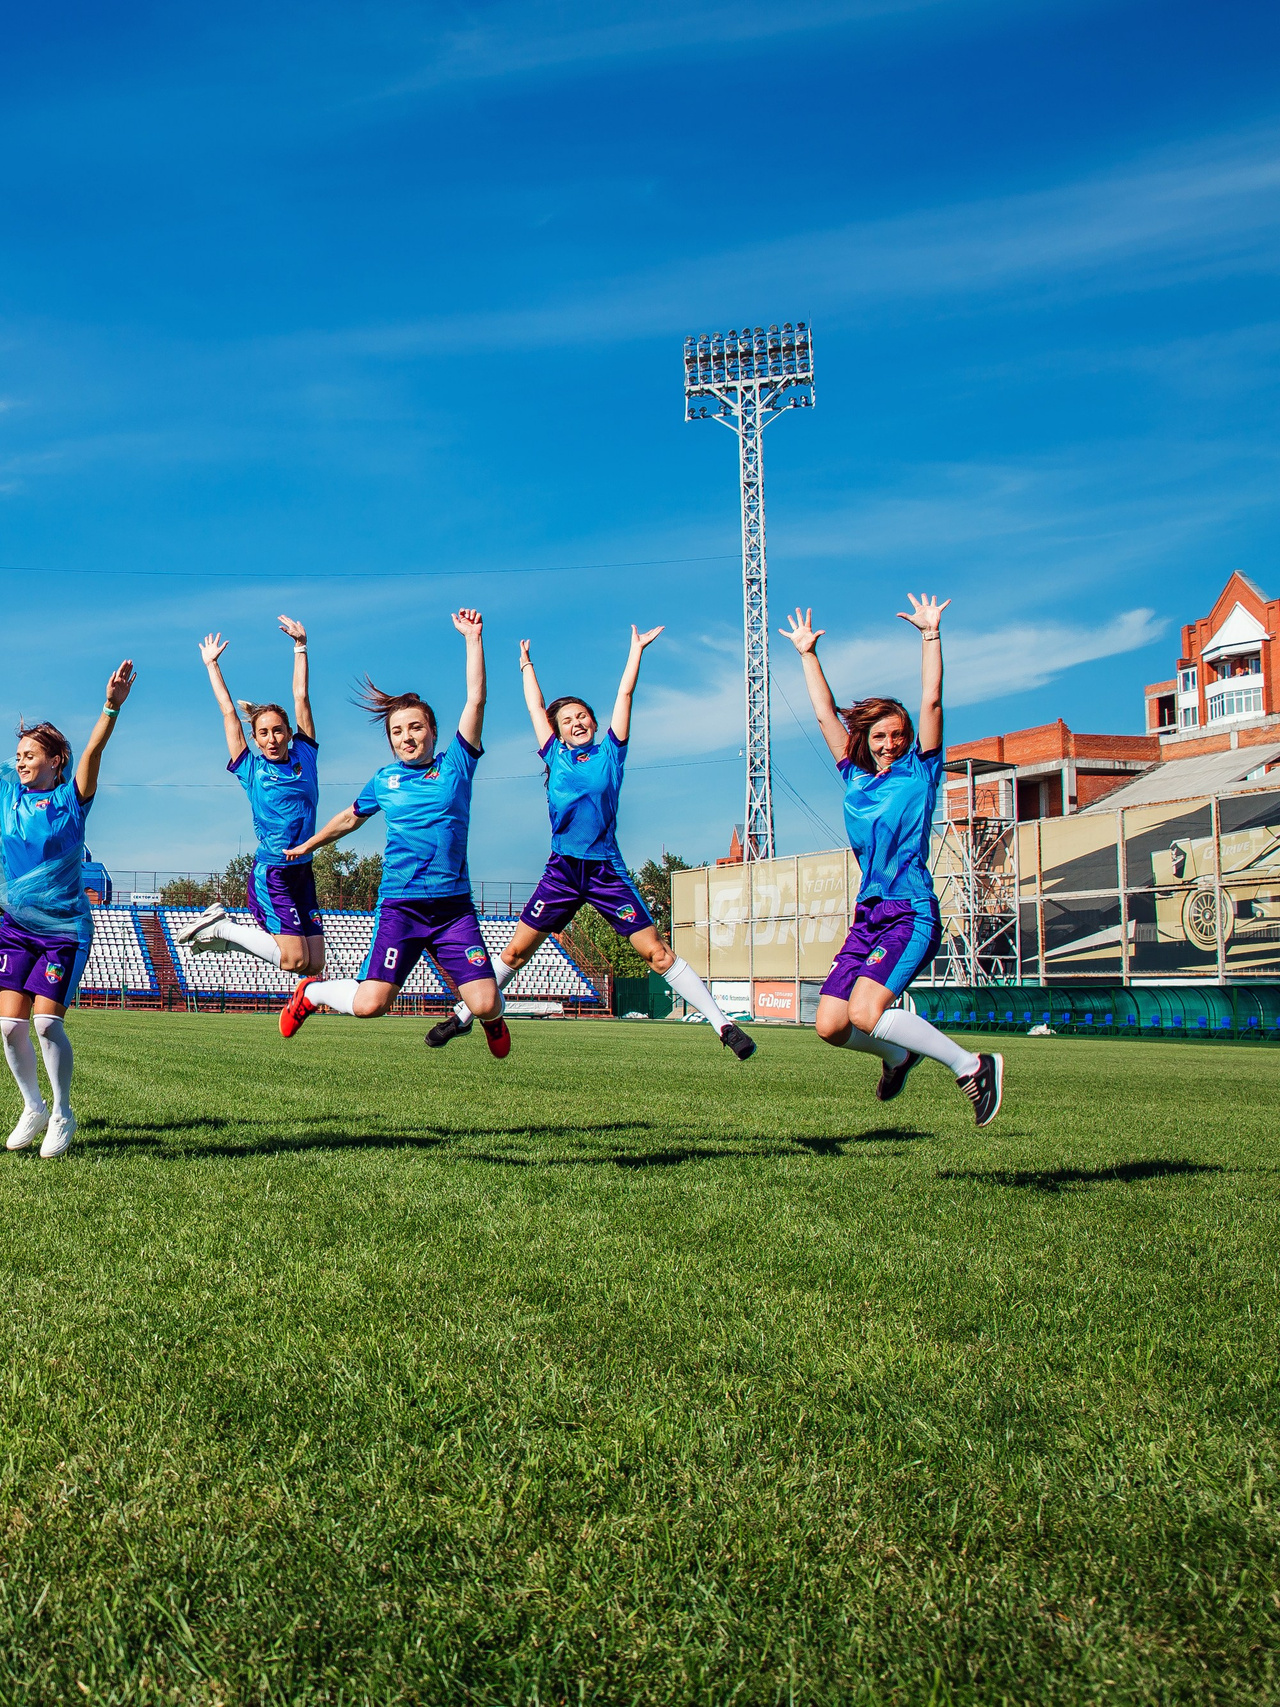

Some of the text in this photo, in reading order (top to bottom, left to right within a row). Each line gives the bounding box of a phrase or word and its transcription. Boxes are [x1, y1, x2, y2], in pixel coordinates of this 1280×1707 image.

[388, 774, 400, 789] 8
[289, 907, 301, 926] 3
[530, 899, 545, 918] 9
[384, 947, 399, 969] 8
